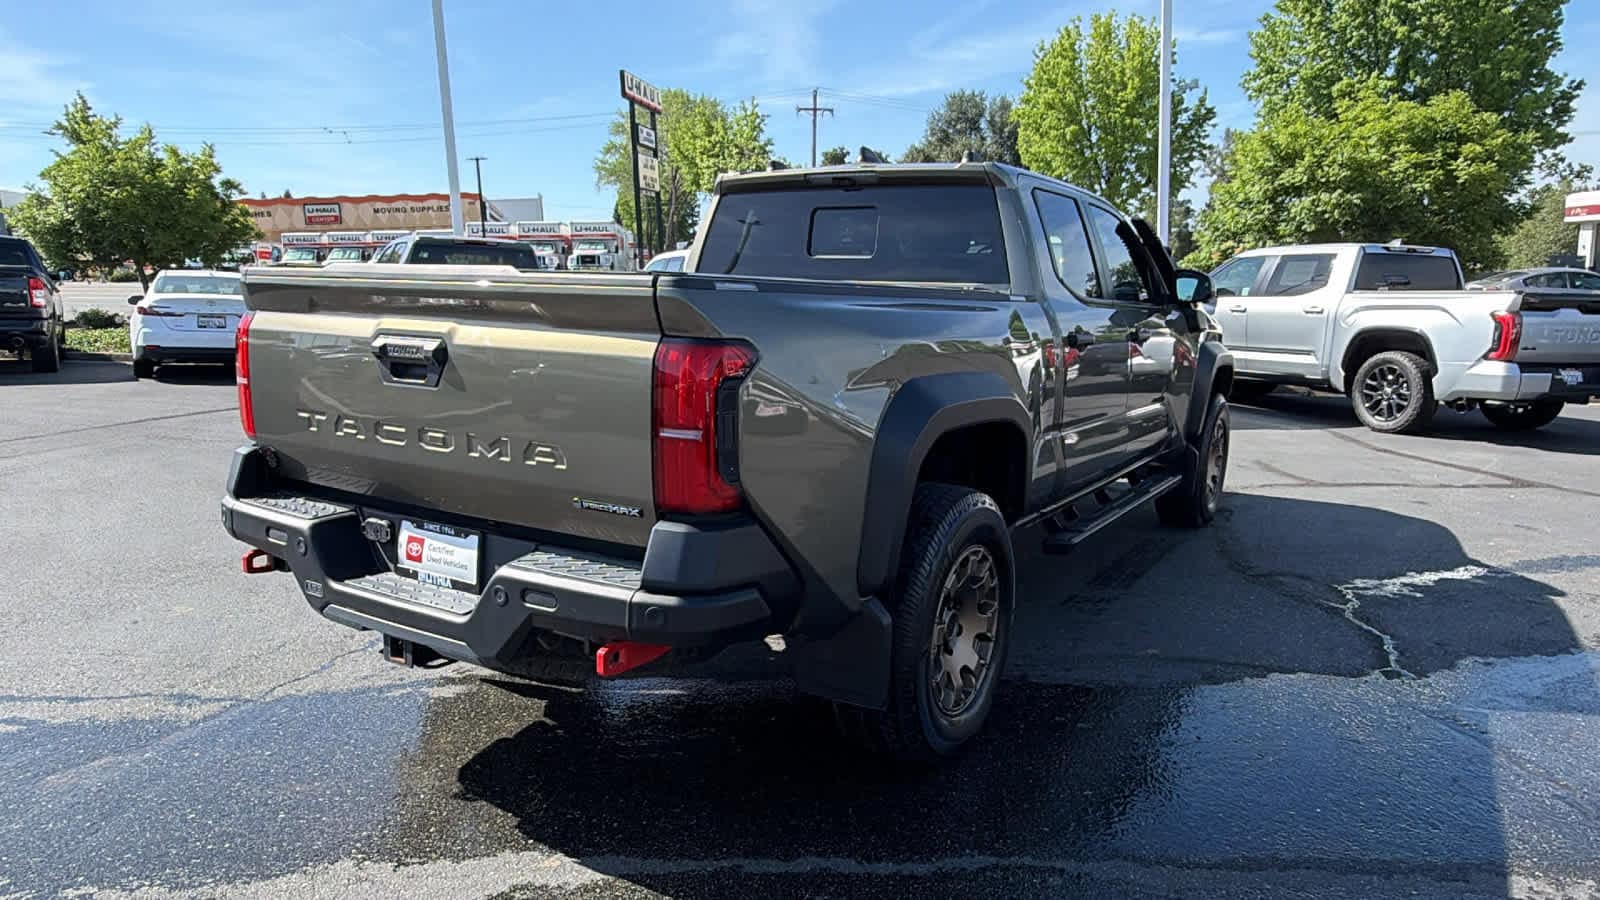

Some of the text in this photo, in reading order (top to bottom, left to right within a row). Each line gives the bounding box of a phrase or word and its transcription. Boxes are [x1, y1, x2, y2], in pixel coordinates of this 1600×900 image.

[373, 205, 450, 214] MOVING SUPPLIES
[522, 225, 557, 233] U-HAUL
[574, 224, 609, 233] U-HAUL
[387, 343, 425, 360] TOYOTA
[296, 411, 568, 471] TACOMA
[423, 521, 441, 533] SINCE
[427, 542, 456, 556] Certified
[426, 552, 469, 572] Used Vehicles
